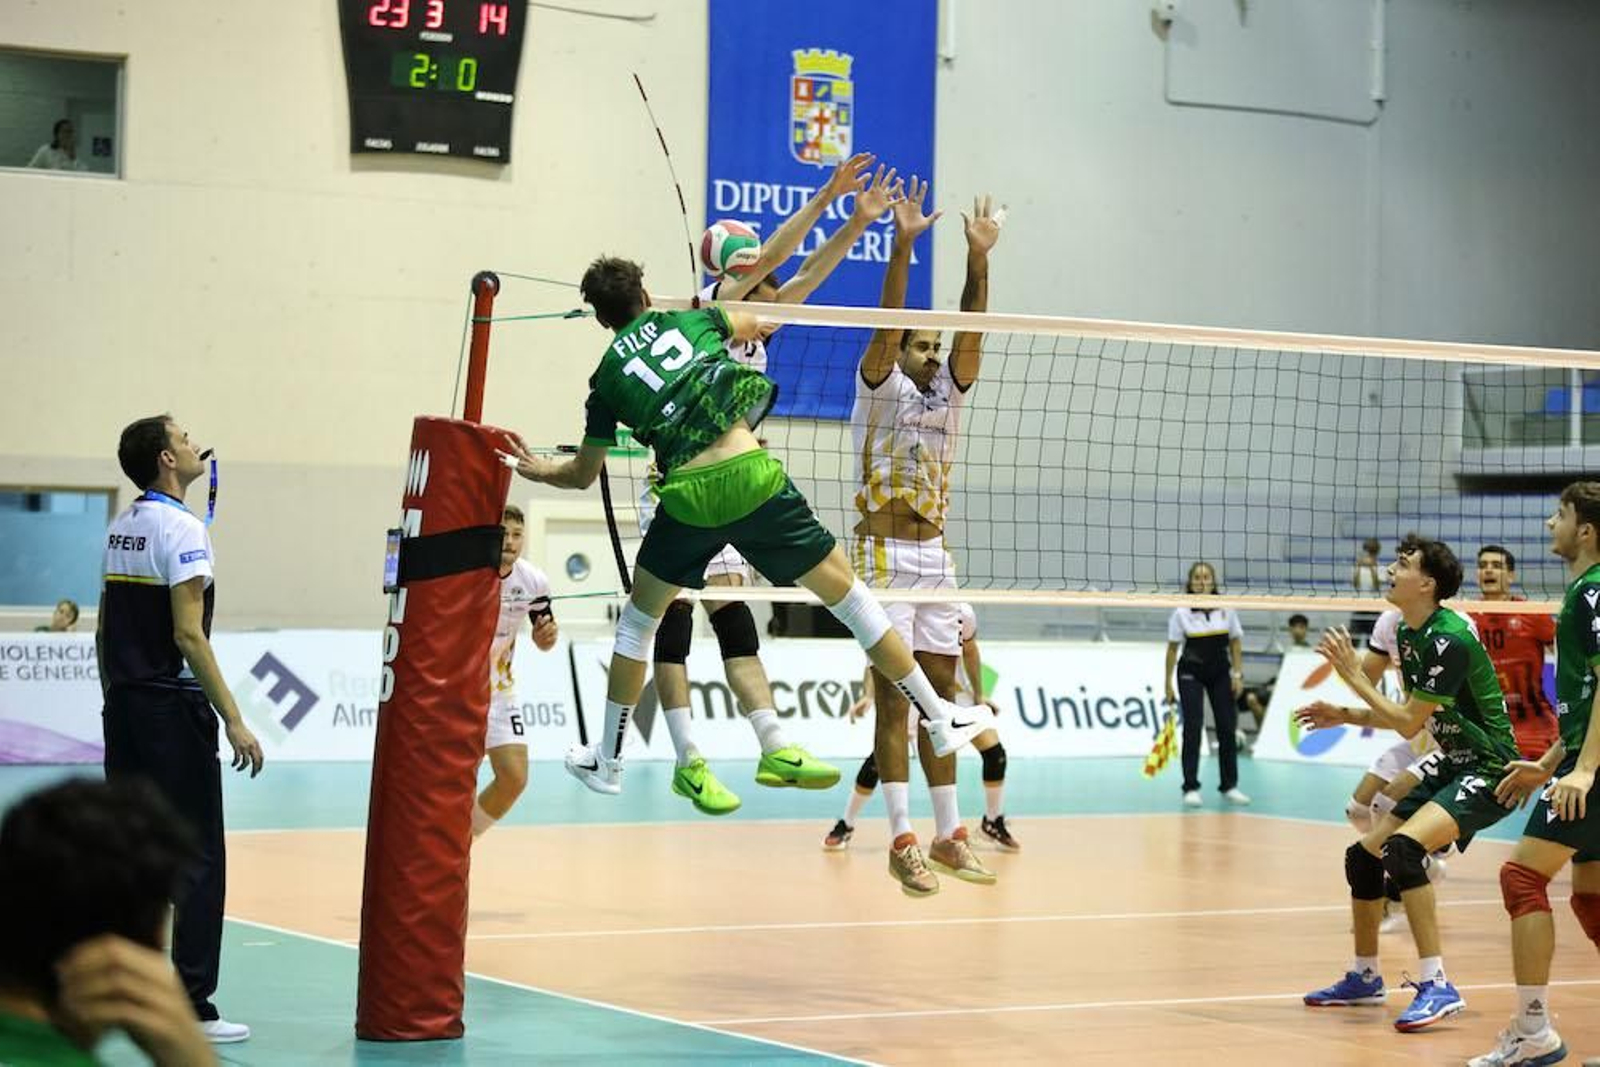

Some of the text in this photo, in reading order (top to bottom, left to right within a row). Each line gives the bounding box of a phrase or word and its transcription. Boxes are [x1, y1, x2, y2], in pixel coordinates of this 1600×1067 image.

[369, 0, 507, 35] 23 3 14
[612, 321, 659, 358] FILIP
[622, 328, 694, 393] 13
[510, 715, 525, 736] 6
